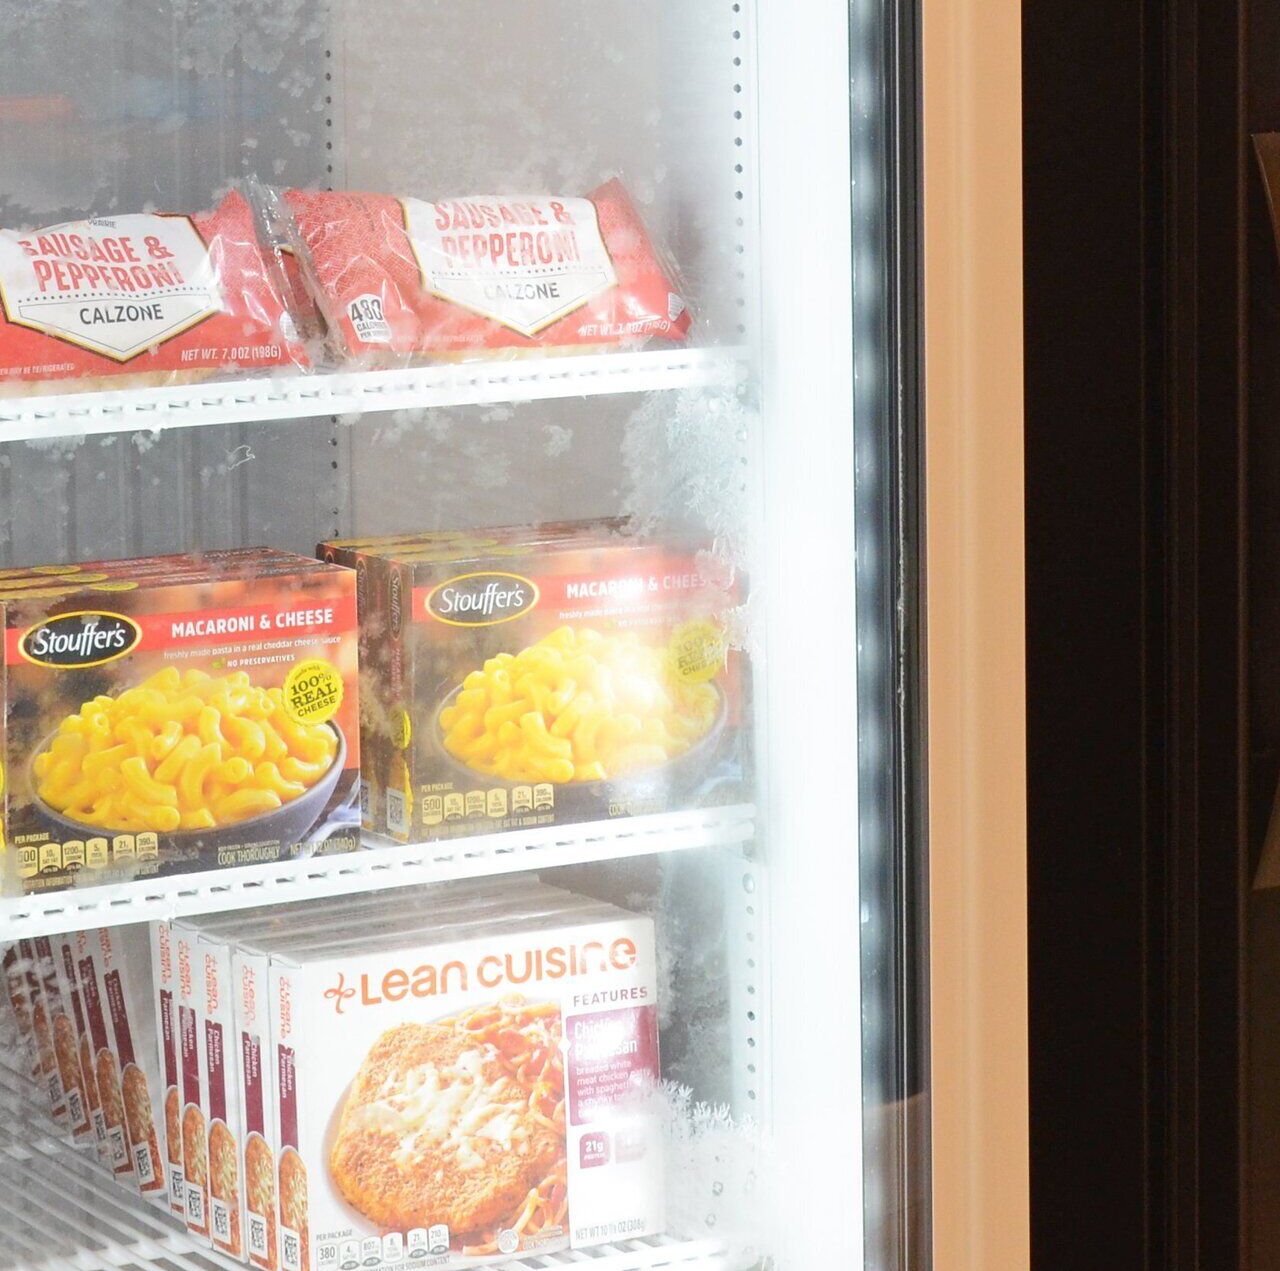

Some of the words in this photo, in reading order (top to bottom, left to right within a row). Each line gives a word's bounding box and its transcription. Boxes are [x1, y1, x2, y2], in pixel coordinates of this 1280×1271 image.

[434, 203, 549, 231] SAUSAGE
[550, 201, 576, 225] &
[18, 236, 141, 260] SAUSAGE
[144, 235, 177, 259] &
[442, 232, 582, 268] PEPPERONI
[33, 260, 186, 294] PEPPERONI
[79, 304, 164, 325] CALZONE
[351, 298, 384, 322] 480
[181, 349, 199, 361] NET
[251, 345, 282, 361] (198G)
[438, 581, 524, 617] Stouffer's
[172, 616, 254, 638] MACARONI
[259, 614, 270, 629] &
[276, 608, 333, 628] CHEESE
[33, 623, 126, 657] Stouffer's
[212, 646, 232, 657] pasta
[248, 642, 262, 652] real
[263, 639, 293, 650] cheddar
[227, 659, 238, 667] NO
[239, 654, 296, 667] PRESERVATIVES
[290, 672, 332, 696] 100%
[290, 680, 338, 710] REAL
[297, 695, 337, 718] CHEESE
[360, 957, 468, 1007] Lean
[573, 986, 648, 1008] FEATURES
[585, 1139, 604, 1154] 21g
